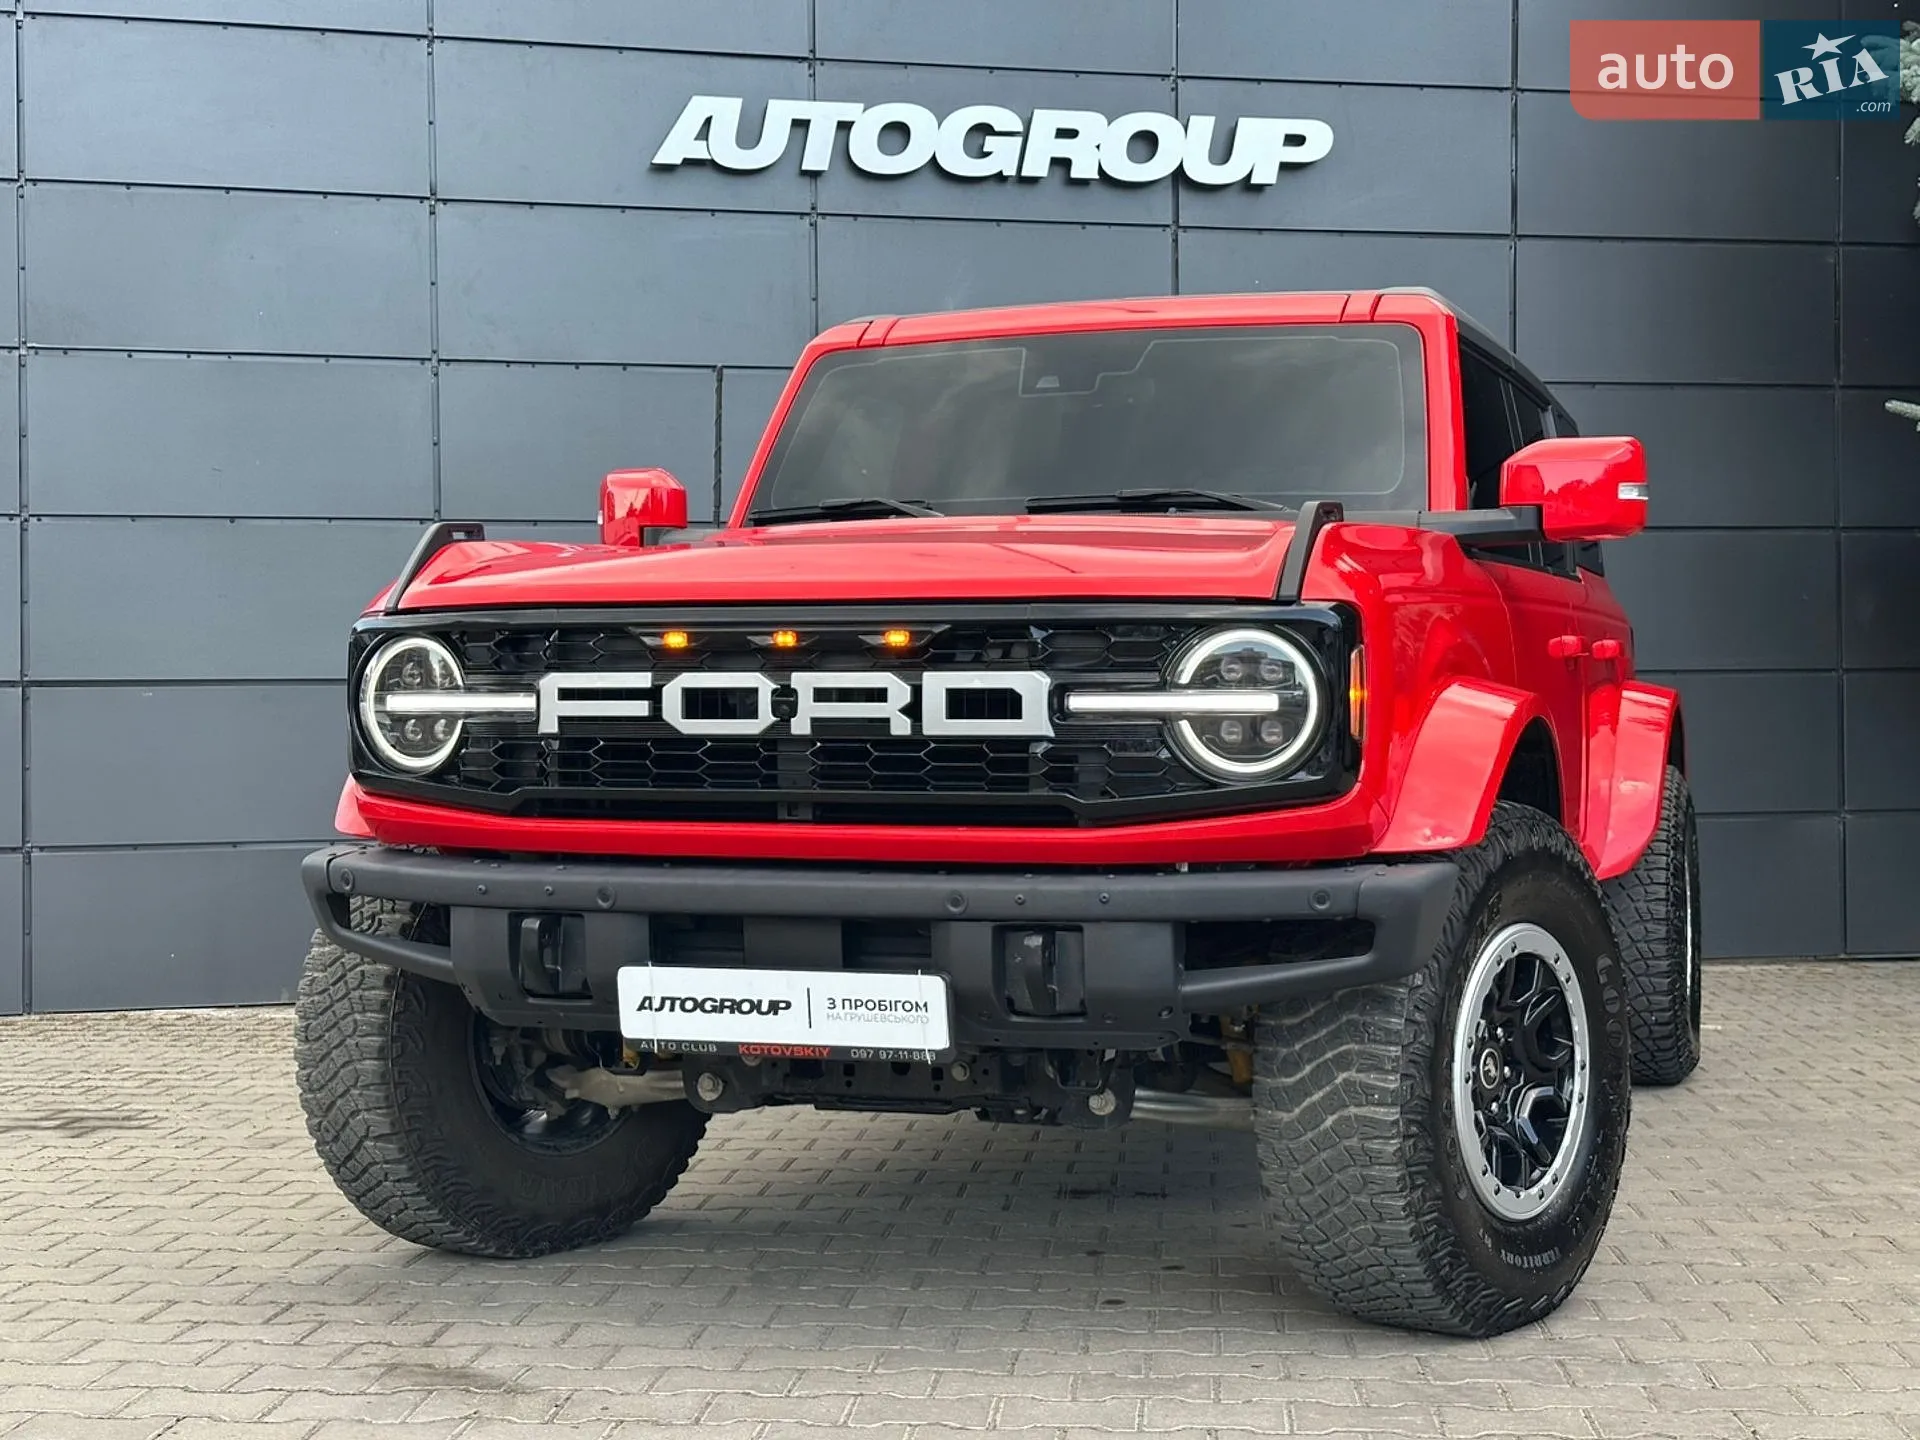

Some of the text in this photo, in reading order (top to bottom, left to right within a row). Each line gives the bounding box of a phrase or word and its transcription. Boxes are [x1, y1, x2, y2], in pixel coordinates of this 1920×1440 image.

[651, 95, 1335, 187] AUTOGROUP
[537, 671, 1056, 738] FORD
[636, 995, 793, 1016] AUTOGROUP
[841, 998, 929, 1014] ПРОБІГОМ
[681, 1043, 718, 1053] CLUB
[739, 1044, 831, 1058] KOTOVSKIY
[851, 1049, 874, 1059] 097
